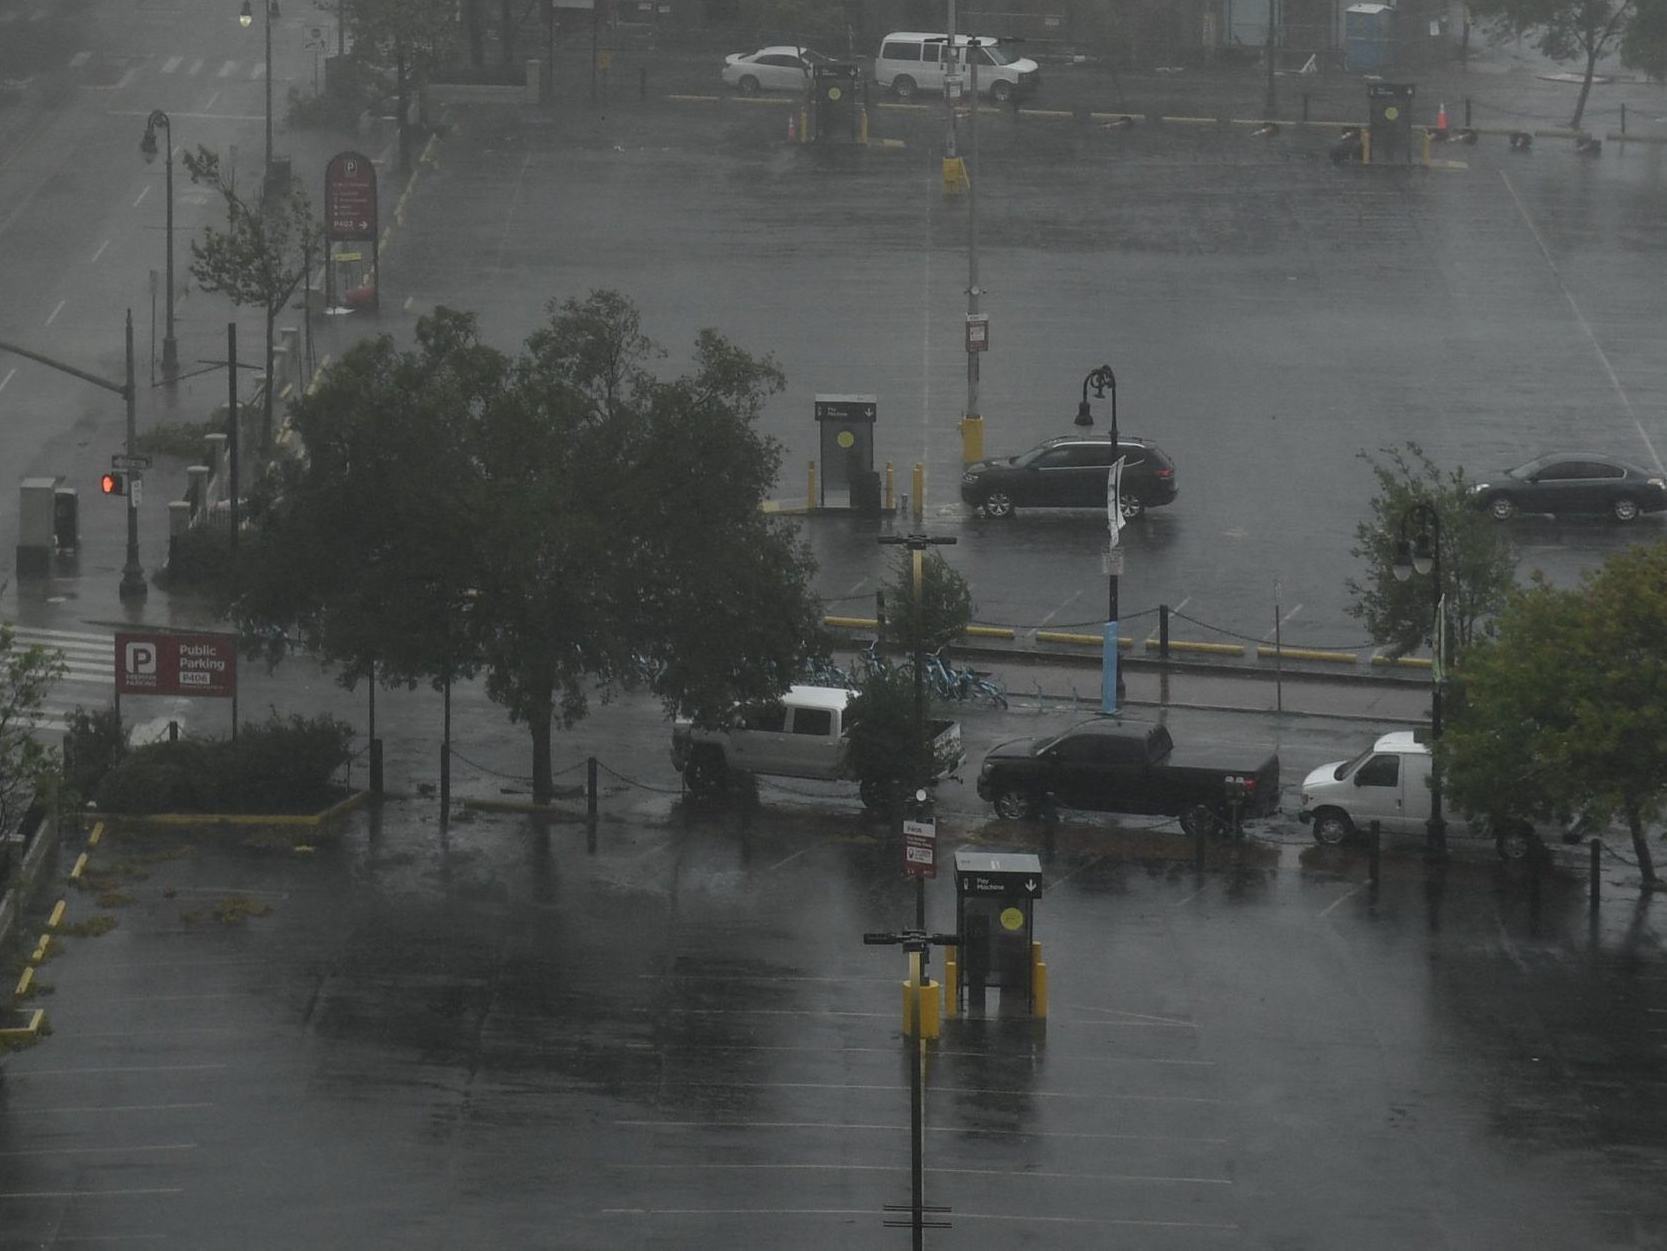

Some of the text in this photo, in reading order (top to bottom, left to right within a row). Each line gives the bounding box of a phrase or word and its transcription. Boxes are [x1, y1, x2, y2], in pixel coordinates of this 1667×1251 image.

[179, 644, 216, 656] Public
[179, 657, 225, 671] Parking
[183, 673, 207, 682] P406
